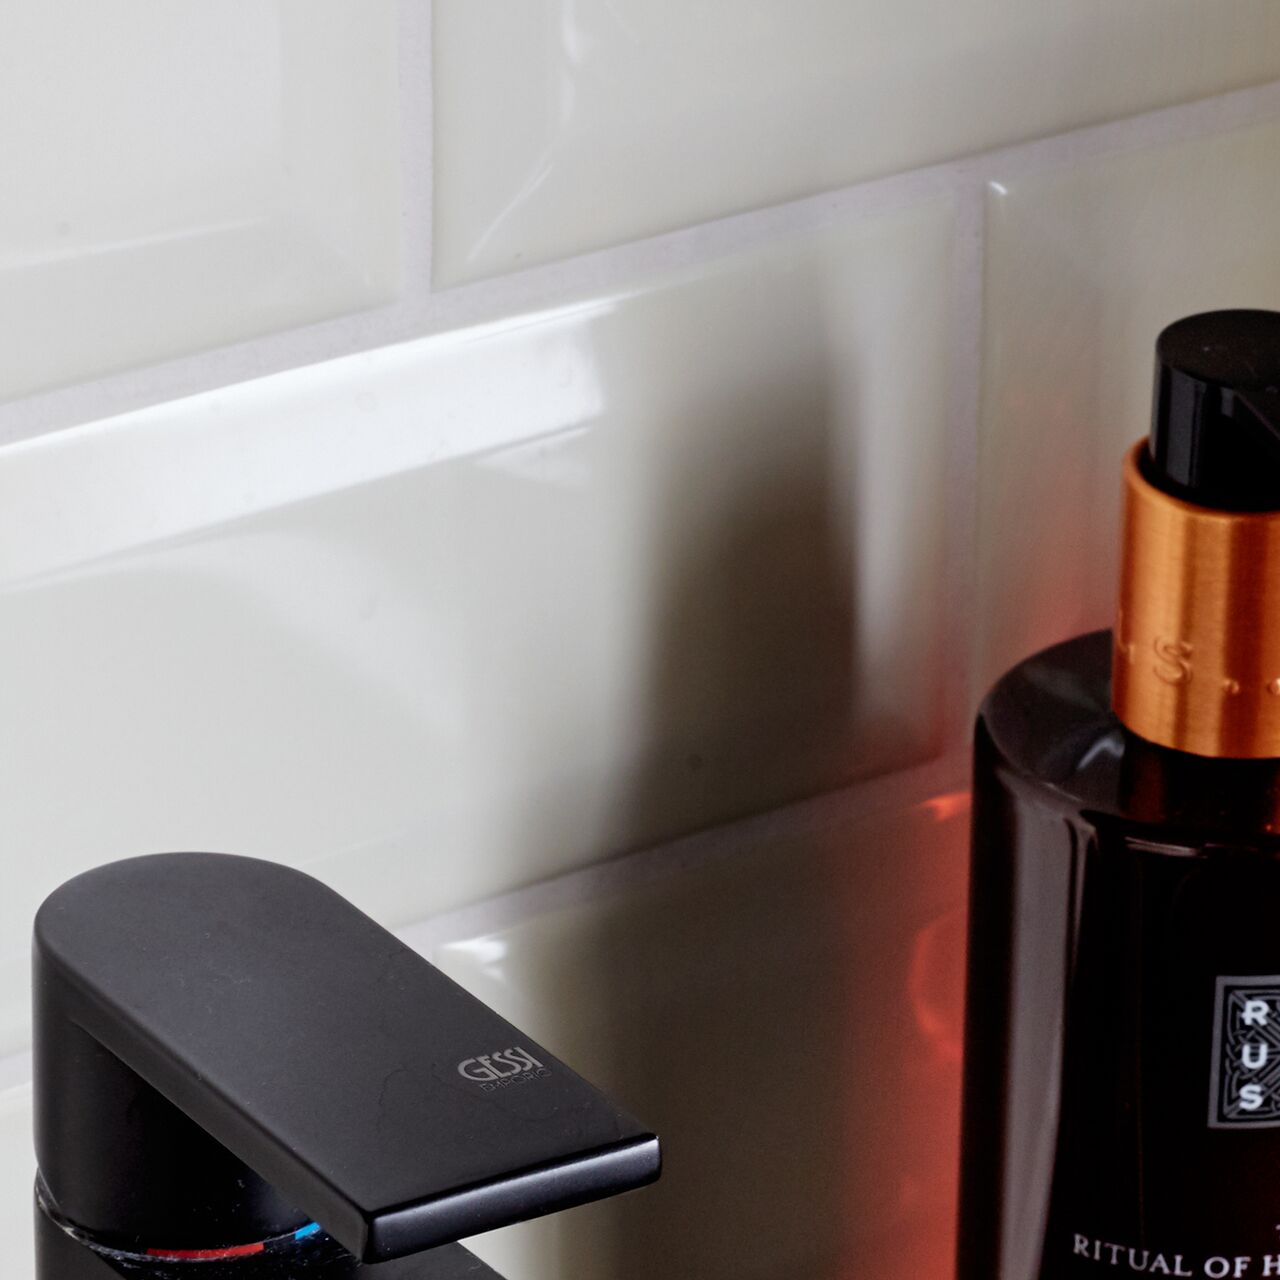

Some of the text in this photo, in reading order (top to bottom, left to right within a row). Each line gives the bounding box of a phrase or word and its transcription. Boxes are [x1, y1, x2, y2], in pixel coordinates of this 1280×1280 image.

[457, 1046, 544, 1081] GESSI
[1071, 1232, 1193, 1278] RITUAL
[1203, 1255, 1252, 1279] OF
